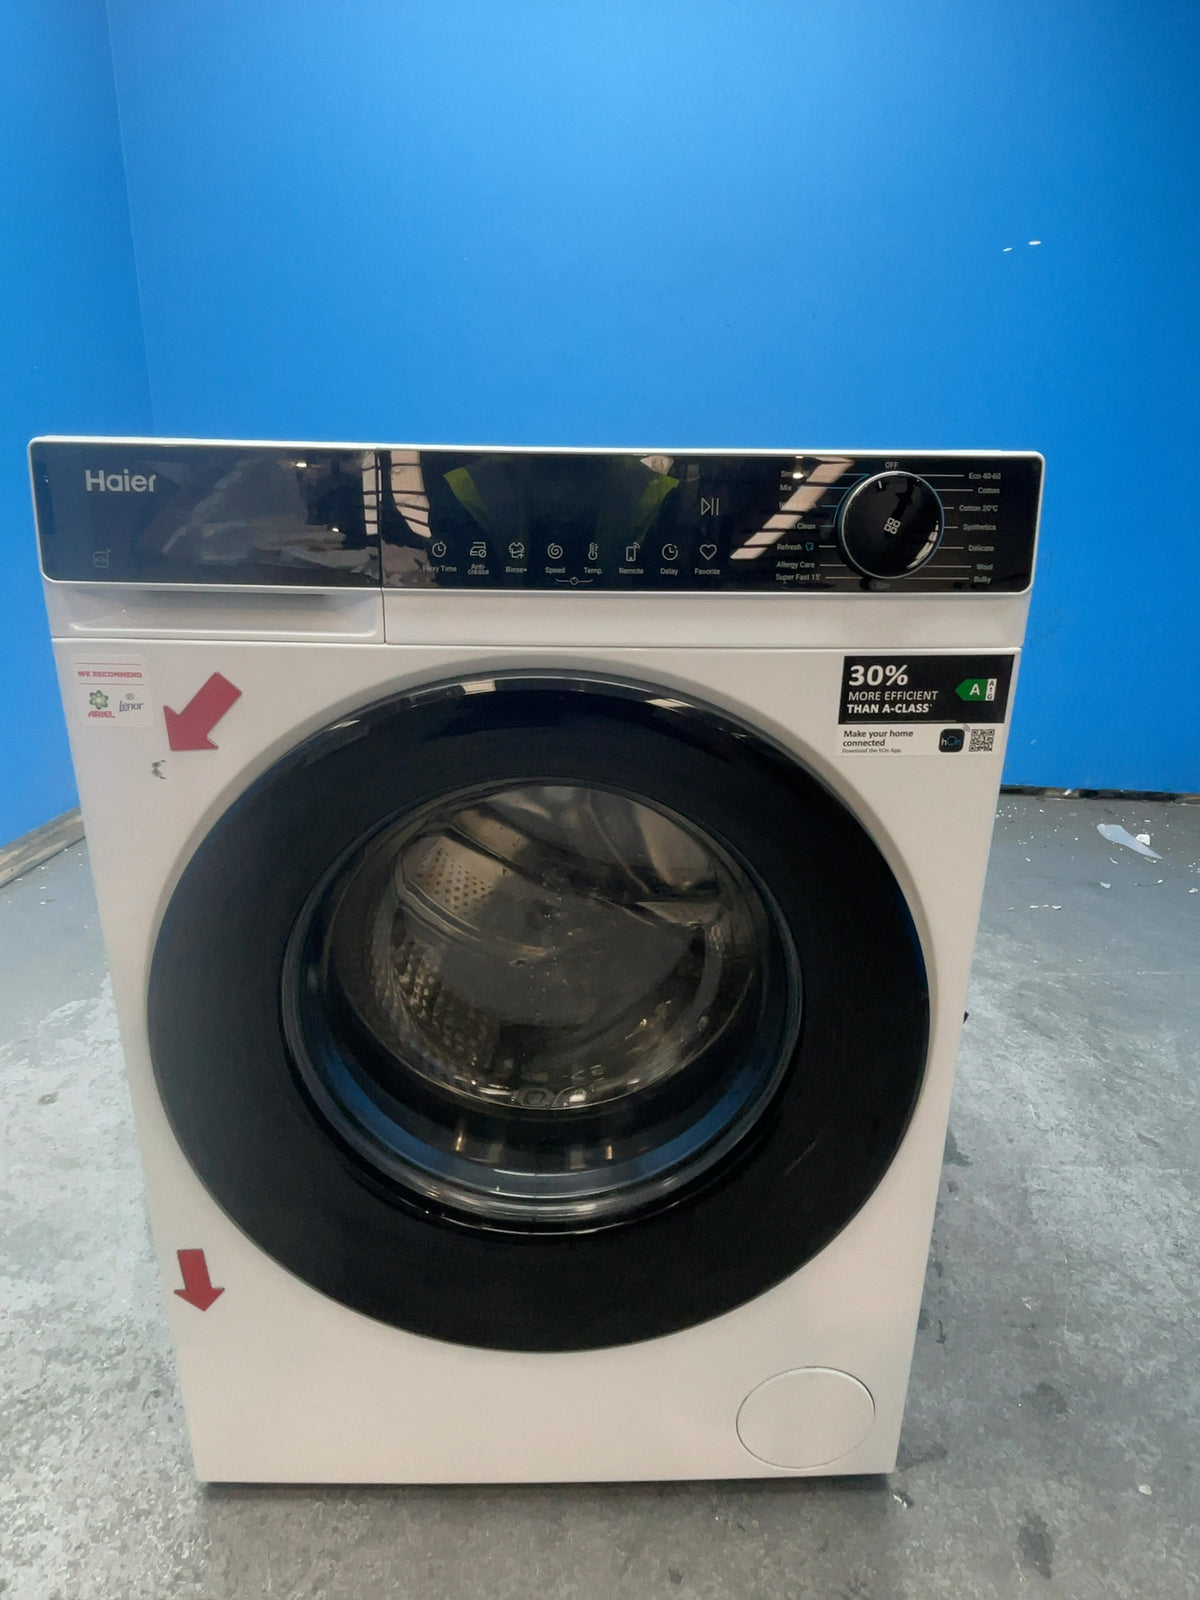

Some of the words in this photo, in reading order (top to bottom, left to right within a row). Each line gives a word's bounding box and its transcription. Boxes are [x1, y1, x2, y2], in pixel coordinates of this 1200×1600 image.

[884, 461, 899, 469] OFF
[968, 472, 981, 480] Eco
[85, 469, 157, 493] Haier
[959, 504, 981, 512] Cotton
[982, 504, 998, 512] 20°C
[963, 524, 997, 532] Synthetics
[776, 543, 802, 551] Refresh
[440, 564, 458, 572] Time
[776, 561, 799, 570] Allergy
[544, 566, 566, 575] Speed
[618, 568, 644, 576] Remote
[660, 568, 679, 576] Delay
[694, 567, 721, 576] Favorite
[776, 574, 794, 582] Super
[92, 670, 142, 678] RECOMMEND
[848, 664, 909, 686] 30%
[969, 684, 981, 696] A
[848, 692, 881, 701] MORE
[884, 690, 939, 701] EFFICIENT
[119, 700, 144, 712] Lenor
[847, 704, 880, 714] THAN
[88, 710, 116, 718] ARIEL
[844, 730, 867, 738] Make
[868, 730, 888, 739] your
[890, 730, 914, 738] home
[842, 739, 886, 747] connected
